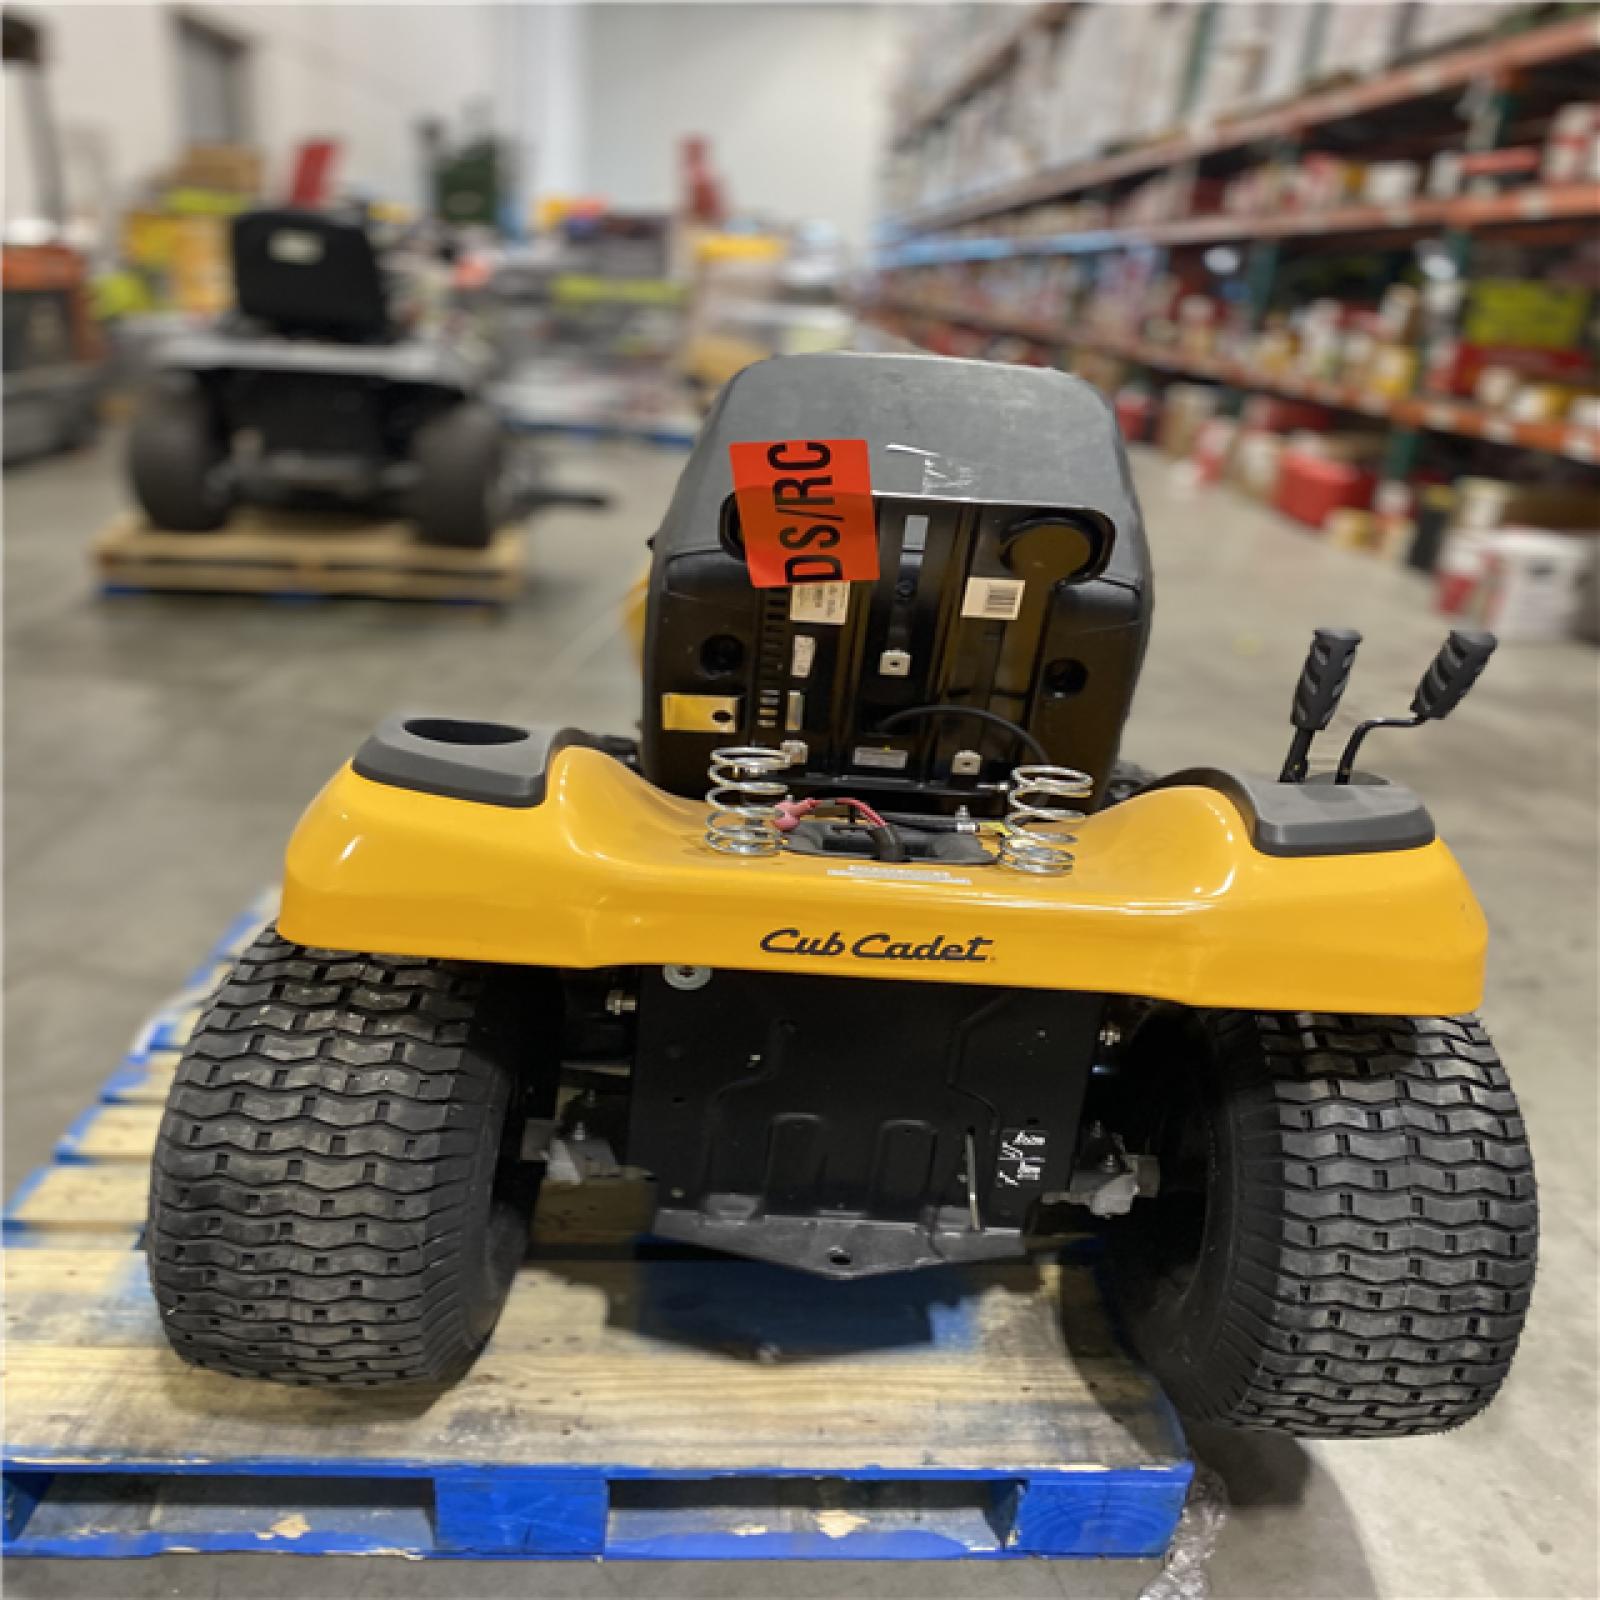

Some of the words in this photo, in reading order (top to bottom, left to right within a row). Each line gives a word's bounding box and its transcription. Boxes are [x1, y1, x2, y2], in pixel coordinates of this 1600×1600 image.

[767, 442, 845, 584] DS/RC
[760, 928, 846, 956] Cub
[852, 933, 995, 961] Cadet
